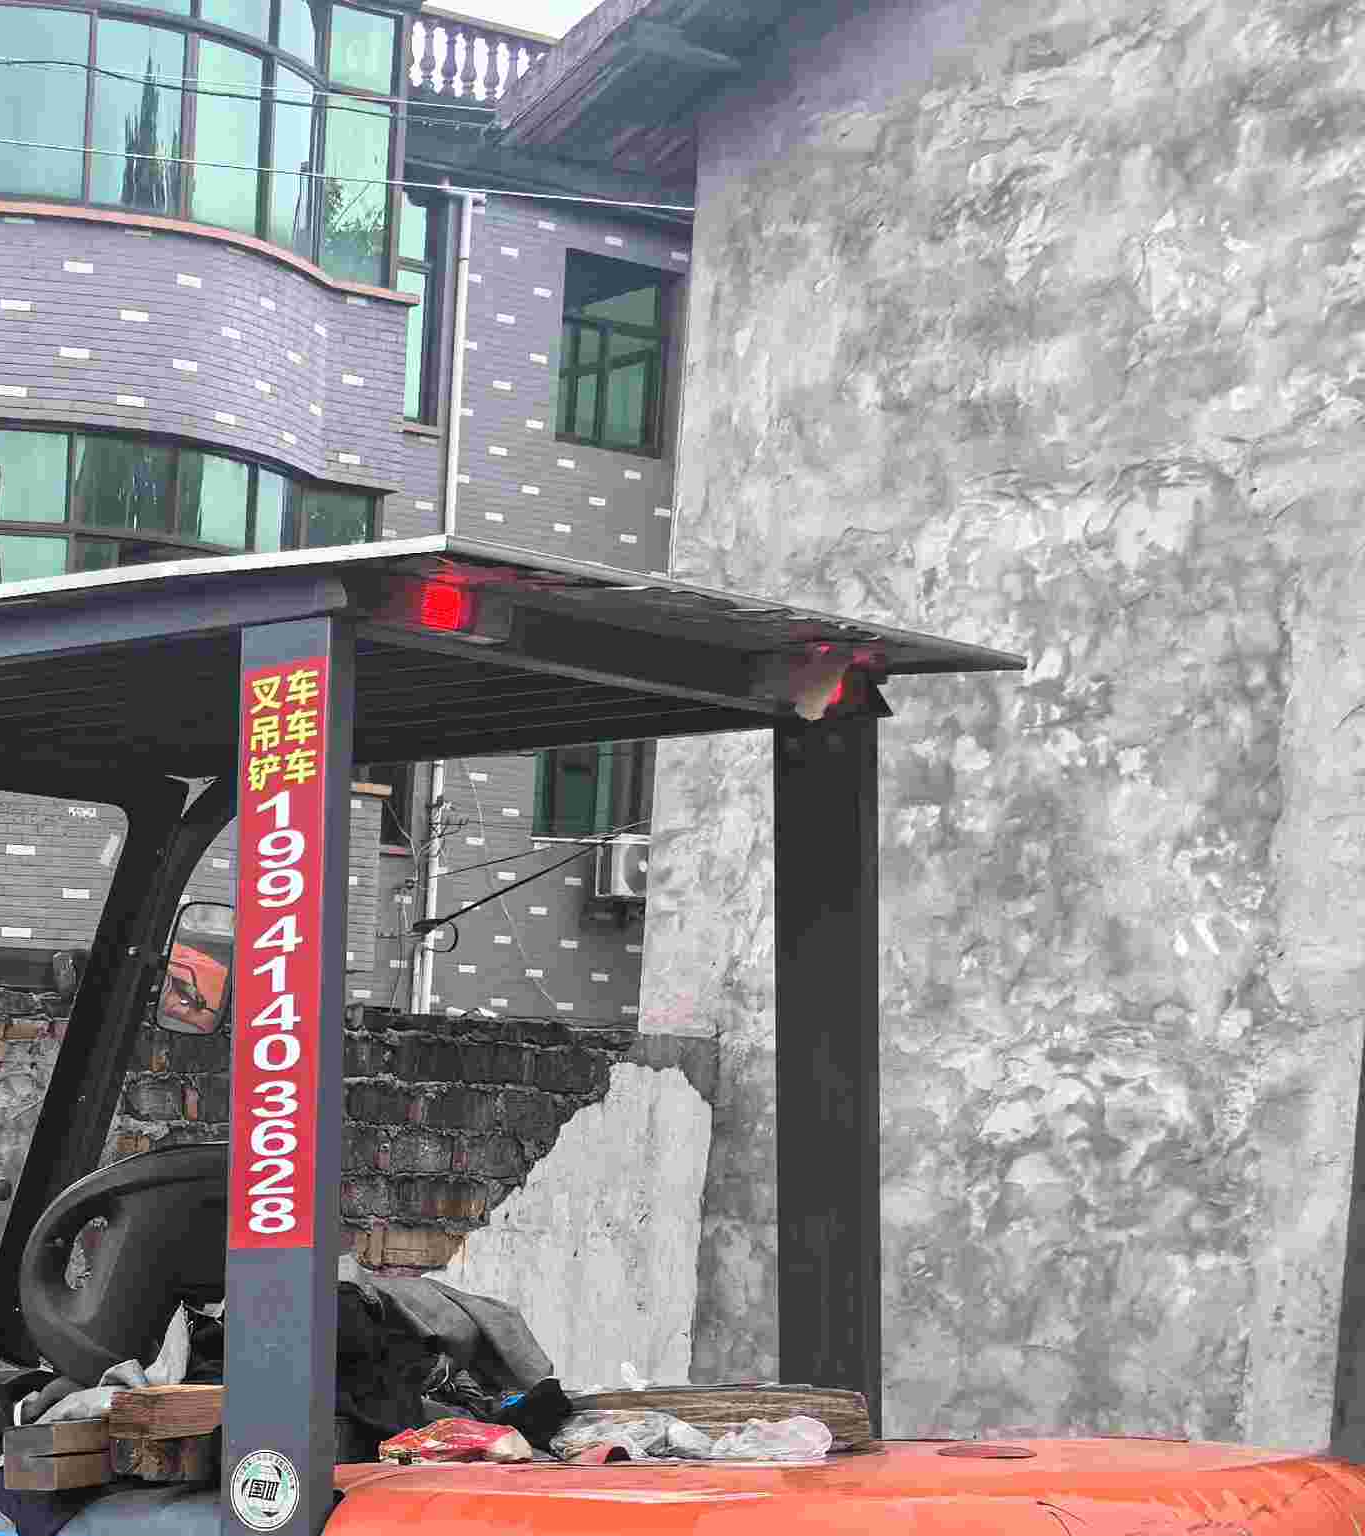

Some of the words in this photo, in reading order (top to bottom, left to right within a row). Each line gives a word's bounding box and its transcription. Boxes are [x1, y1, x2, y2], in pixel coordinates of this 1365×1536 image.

[250, 669, 320, 714] 叉车
[250, 708, 318, 752] 吊车
[247, 747, 317, 792] 铲车
[247, 791, 307, 1235] 19941403628
